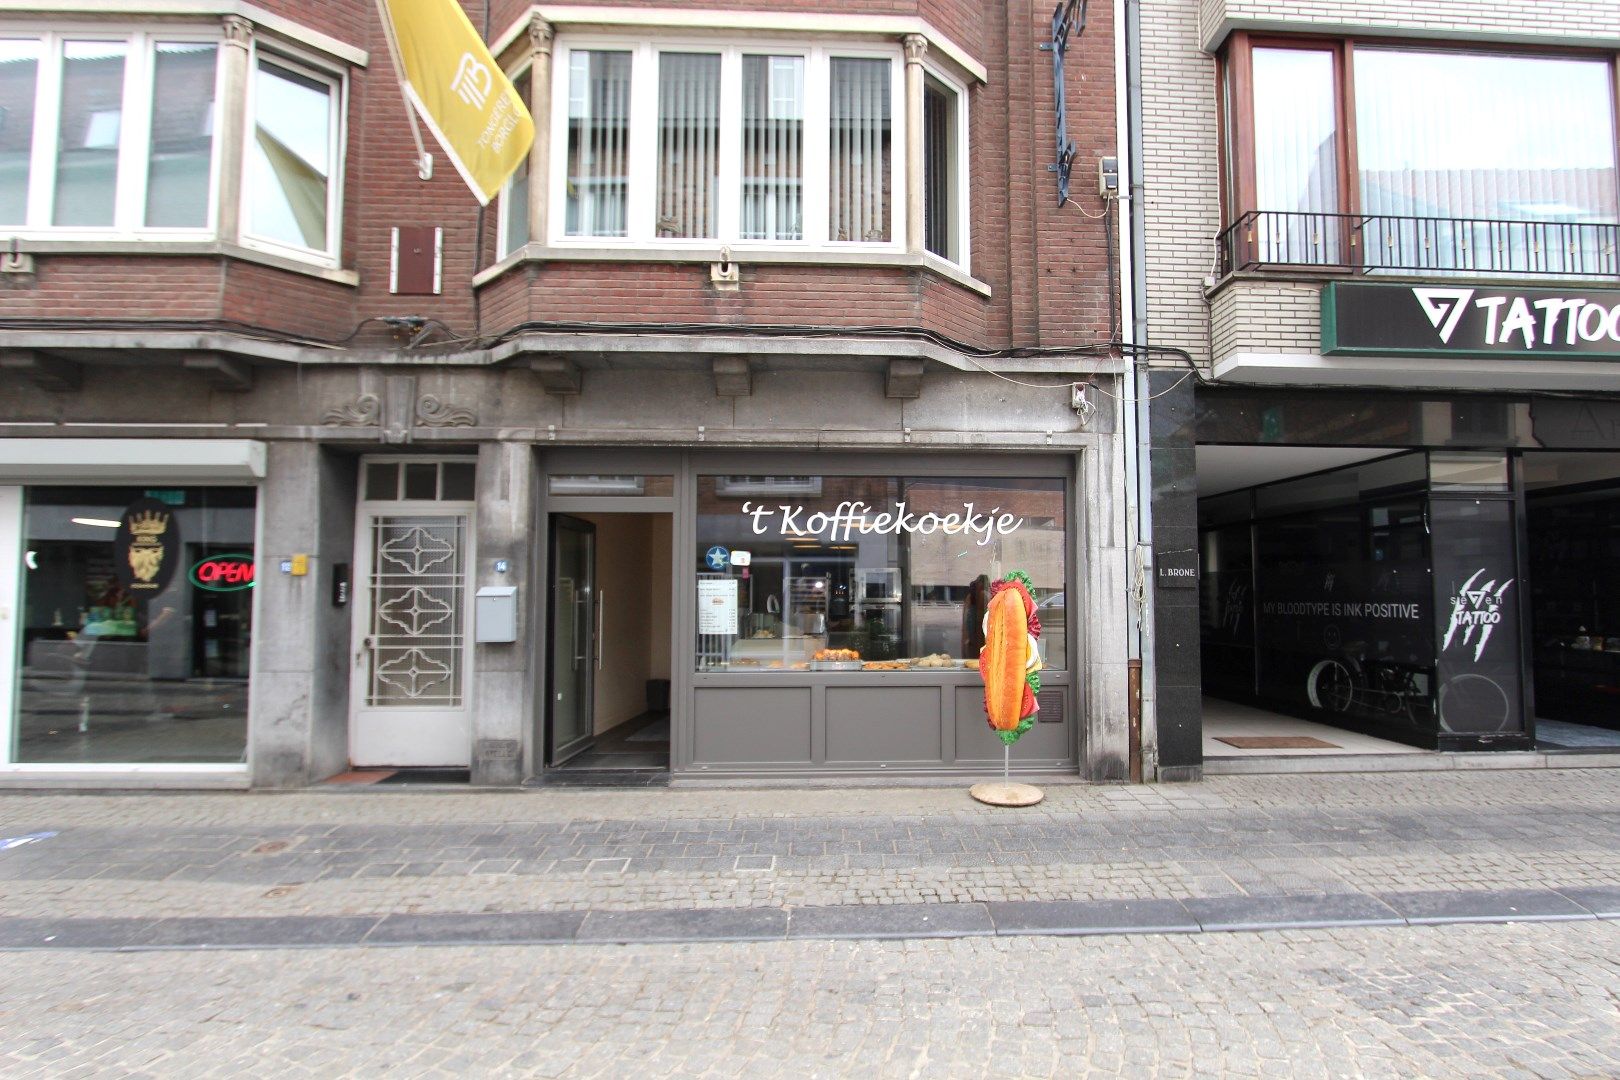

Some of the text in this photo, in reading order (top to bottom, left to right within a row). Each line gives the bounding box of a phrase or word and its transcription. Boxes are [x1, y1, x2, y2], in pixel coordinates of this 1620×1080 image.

[780, 501, 1024, 546] Koffiekoekje
[197, 561, 256, 583] OPEN
[1168, 568, 1195, 577] BRONE
[1263, 602, 1420, 619] MY BLOODTYPE IS INK POSITIVE
[1455, 610, 1502, 626] TATTOO
